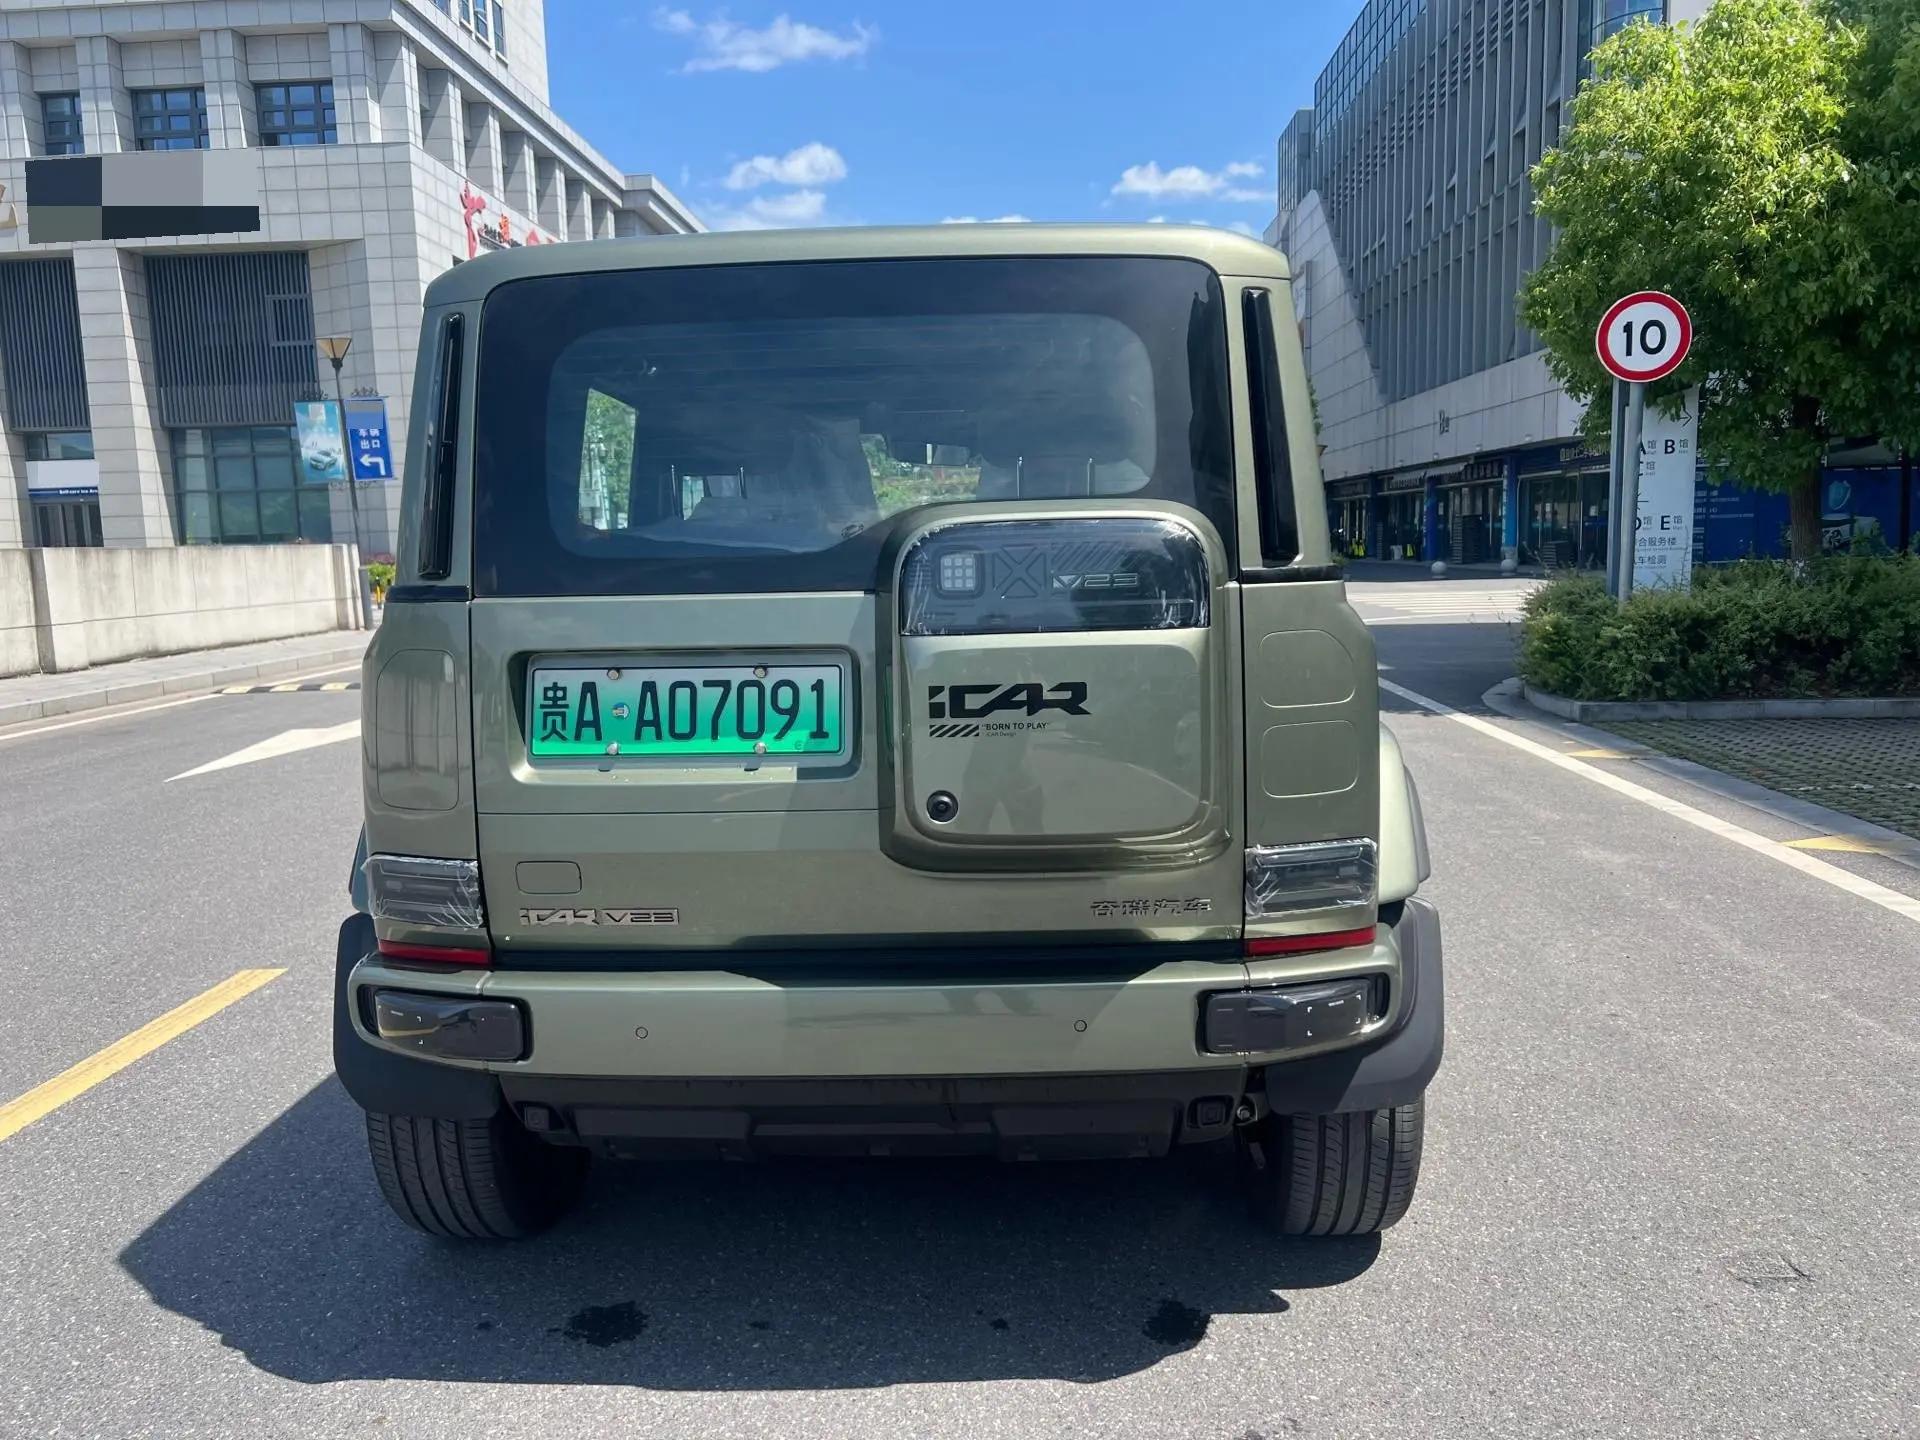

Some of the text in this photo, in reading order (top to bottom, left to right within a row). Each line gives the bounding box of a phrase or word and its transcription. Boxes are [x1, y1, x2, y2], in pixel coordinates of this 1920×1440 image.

[1623, 319, 1667, 357] 10
[361, 440, 380, 449] 出口
[1636, 537, 1676, 547] 合服务楼
[1635, 555, 1666, 565] 车检测
[539, 678, 829, 742] 贵A A07091
[1090, 898, 1211, 917] 奇瑞汽车
